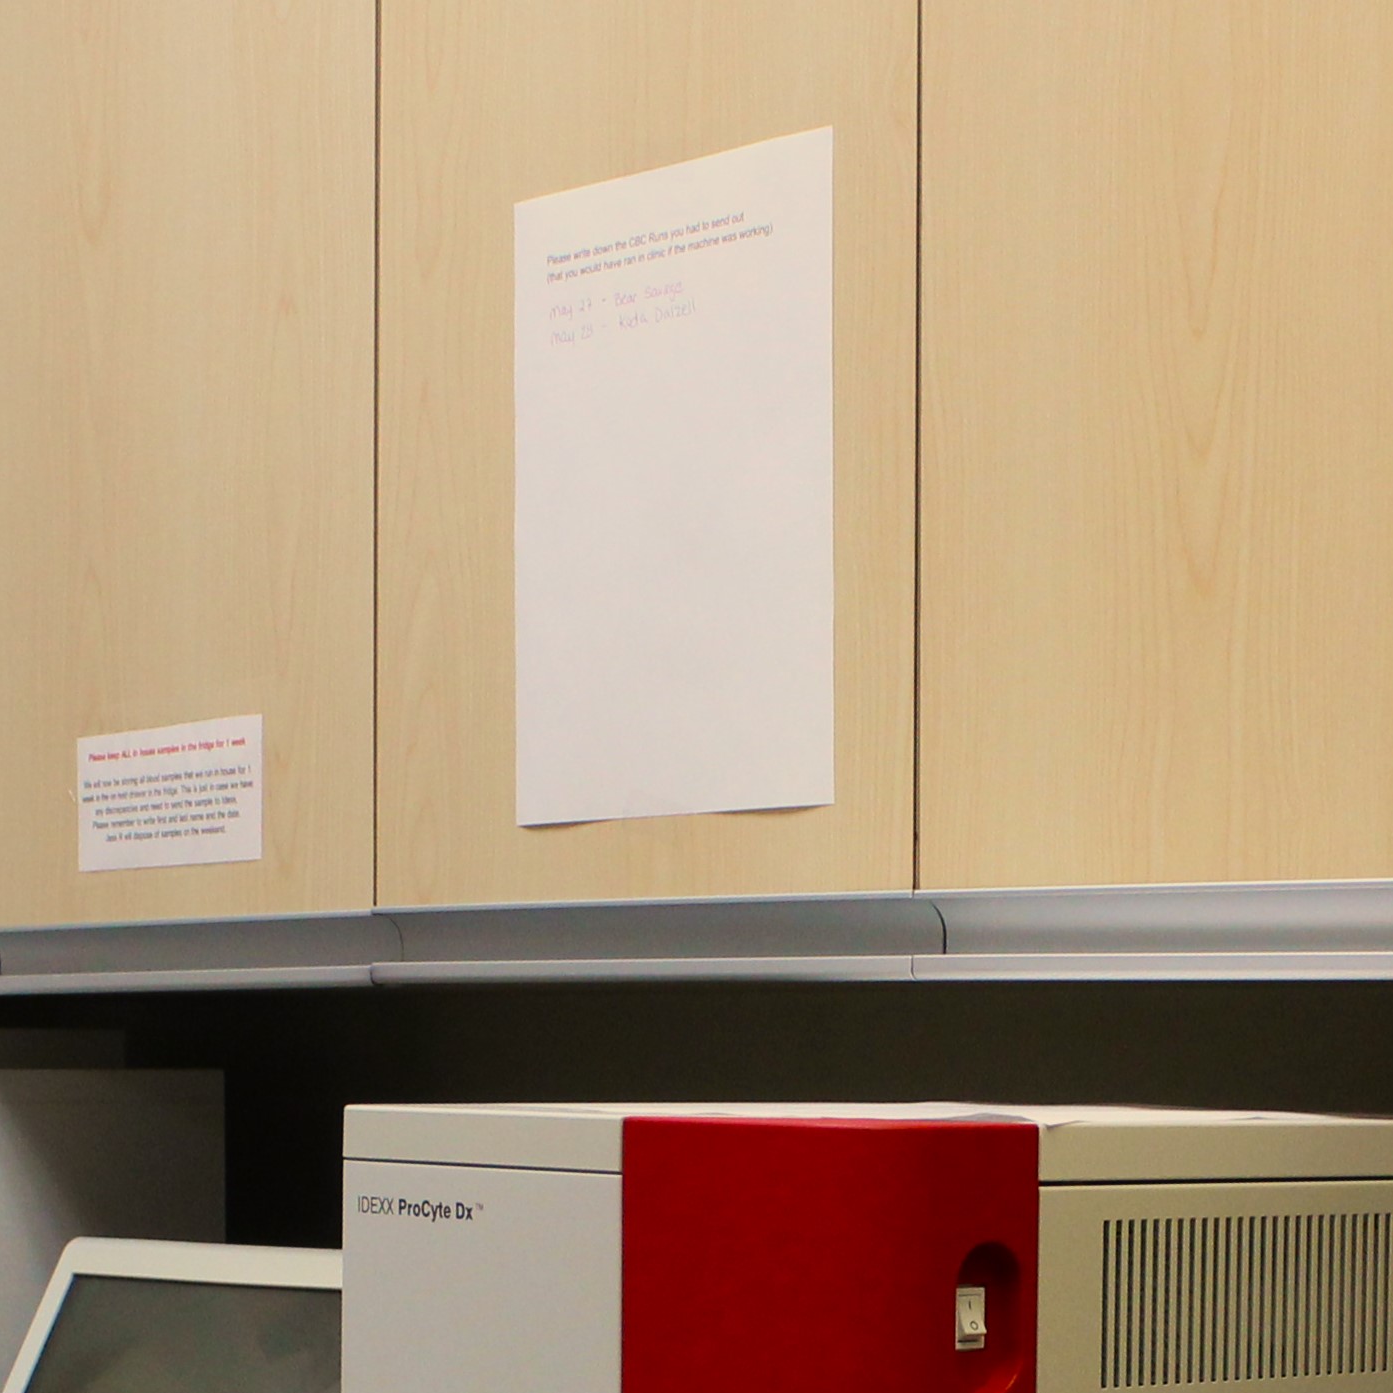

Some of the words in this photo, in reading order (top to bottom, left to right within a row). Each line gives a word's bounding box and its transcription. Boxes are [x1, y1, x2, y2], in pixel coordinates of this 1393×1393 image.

[547, 253, 571, 266] Please
[573, 249, 591, 260] write
[592, 244, 613, 256] down
[615, 241, 627, 252] the
[629, 234, 646, 248] CBC
[648, 231, 668, 243] Runs
[671, 228, 684, 241] you
[686, 221, 700, 234] had
[702, 221, 709, 231] to
[711, 215, 730, 229] send
[731, 212, 744, 223] out
[357, 1195, 394, 1215] IDEXX
[398, 1198, 451, 1222] ProCyte
